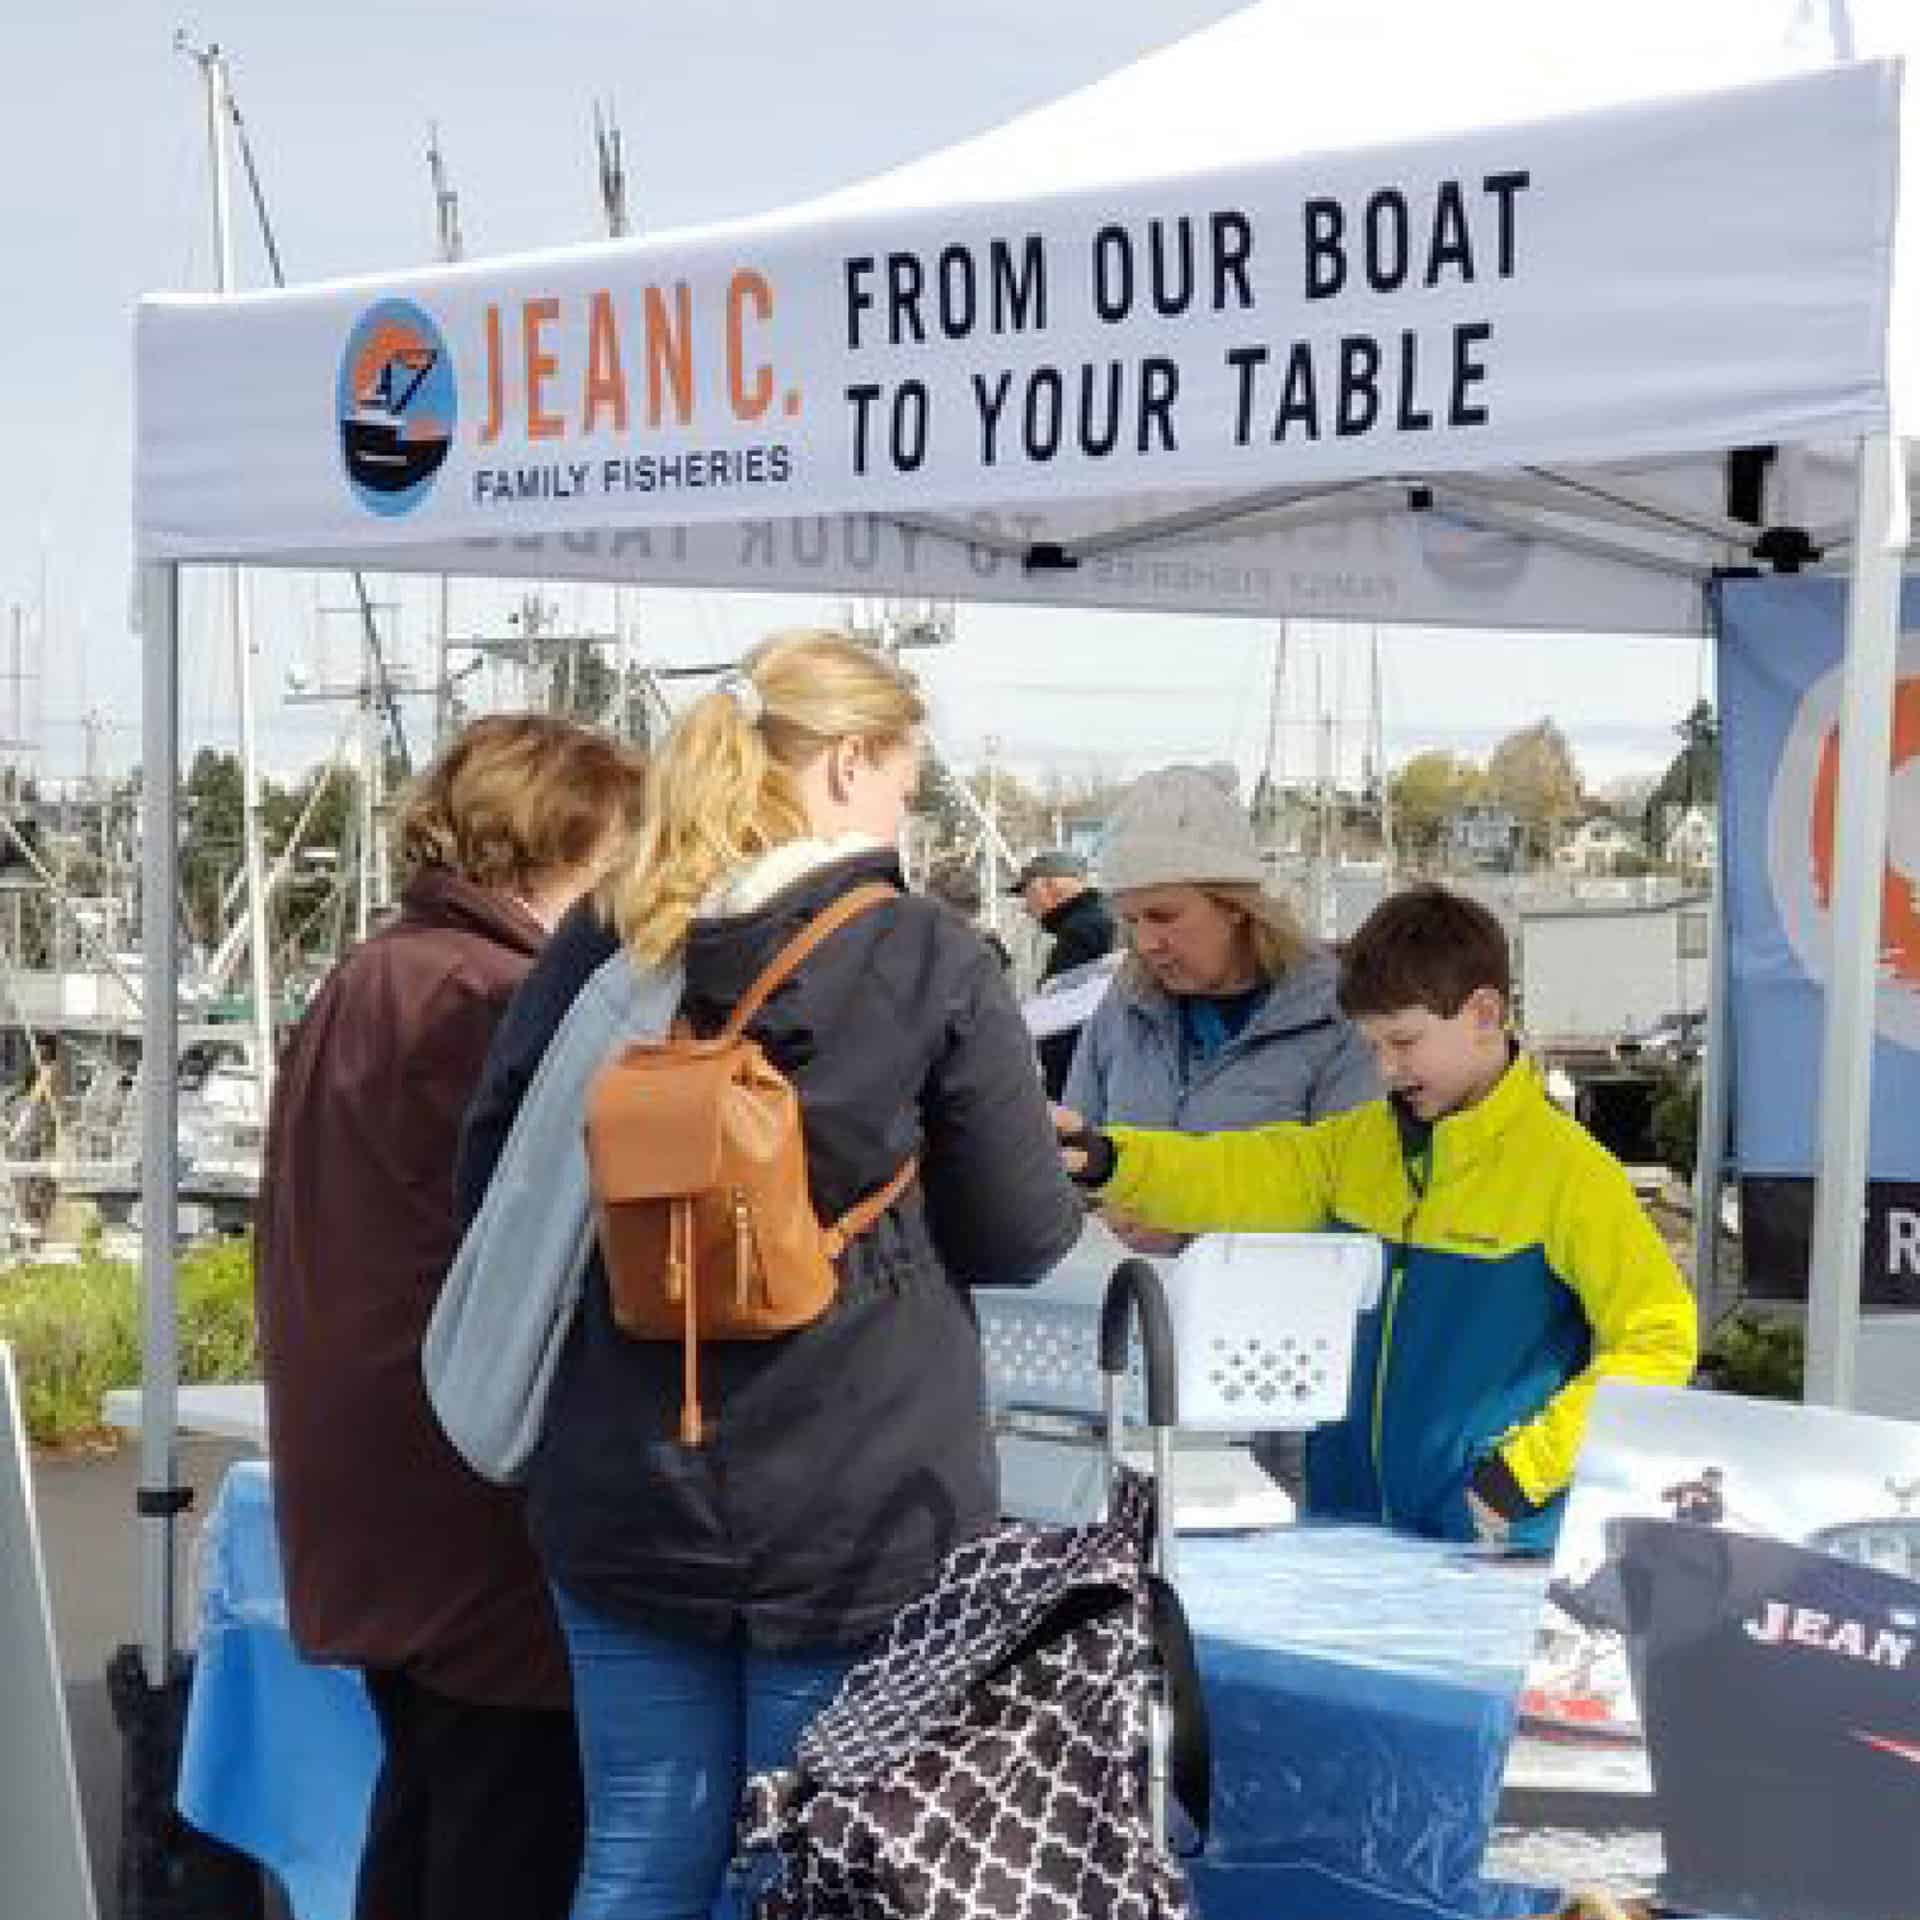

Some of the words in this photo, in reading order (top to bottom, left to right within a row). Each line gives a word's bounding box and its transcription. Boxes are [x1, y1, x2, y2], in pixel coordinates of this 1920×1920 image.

[844, 233, 1047, 348] FROM
[1092, 211, 1254, 323] OUR
[1304, 171, 1530, 300] BOAT
[478, 281, 692, 444] JEAN
[727, 268, 801, 421] C.
[844, 377, 928, 475] TO
[971, 356, 1180, 465] YOUR
[1225, 322, 1493, 445] TABLE
[472, 463, 588, 503] FAMILY
[604, 445, 792, 493] FISHERIES
[1742, 1601, 1913, 1669] JEAN
